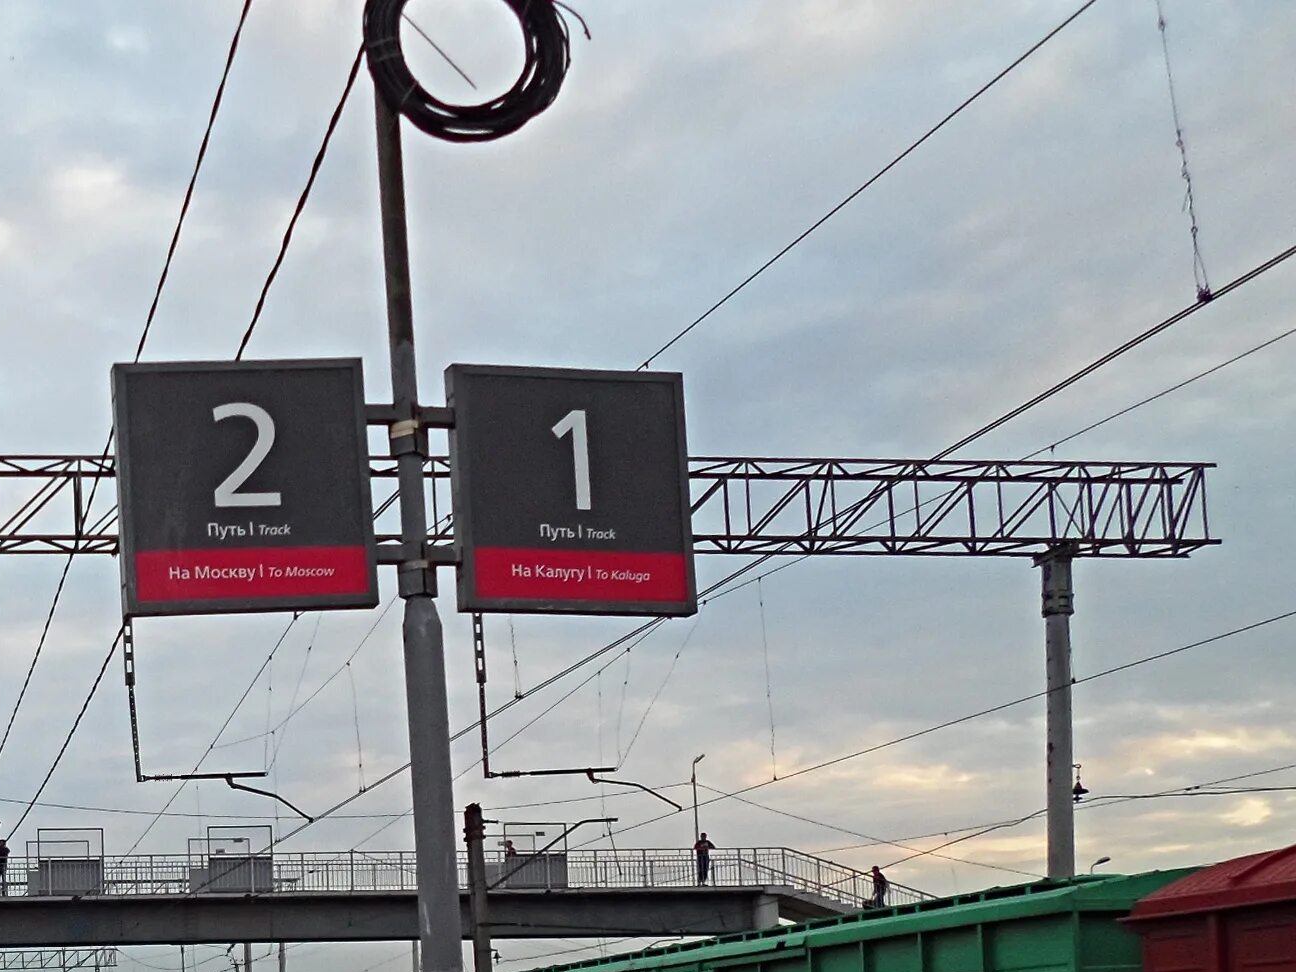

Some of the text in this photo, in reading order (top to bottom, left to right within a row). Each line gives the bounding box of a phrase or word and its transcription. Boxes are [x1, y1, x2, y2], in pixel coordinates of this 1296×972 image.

[212, 402, 281, 507] 2
[551, 410, 591, 510] 1
[207, 522, 292, 540] Путь Track
[539, 523, 616, 541] Путь Track
[168, 565, 335, 582] На Москву To Moscow
[511, 564, 651, 583] На Калугу To Kaluga
